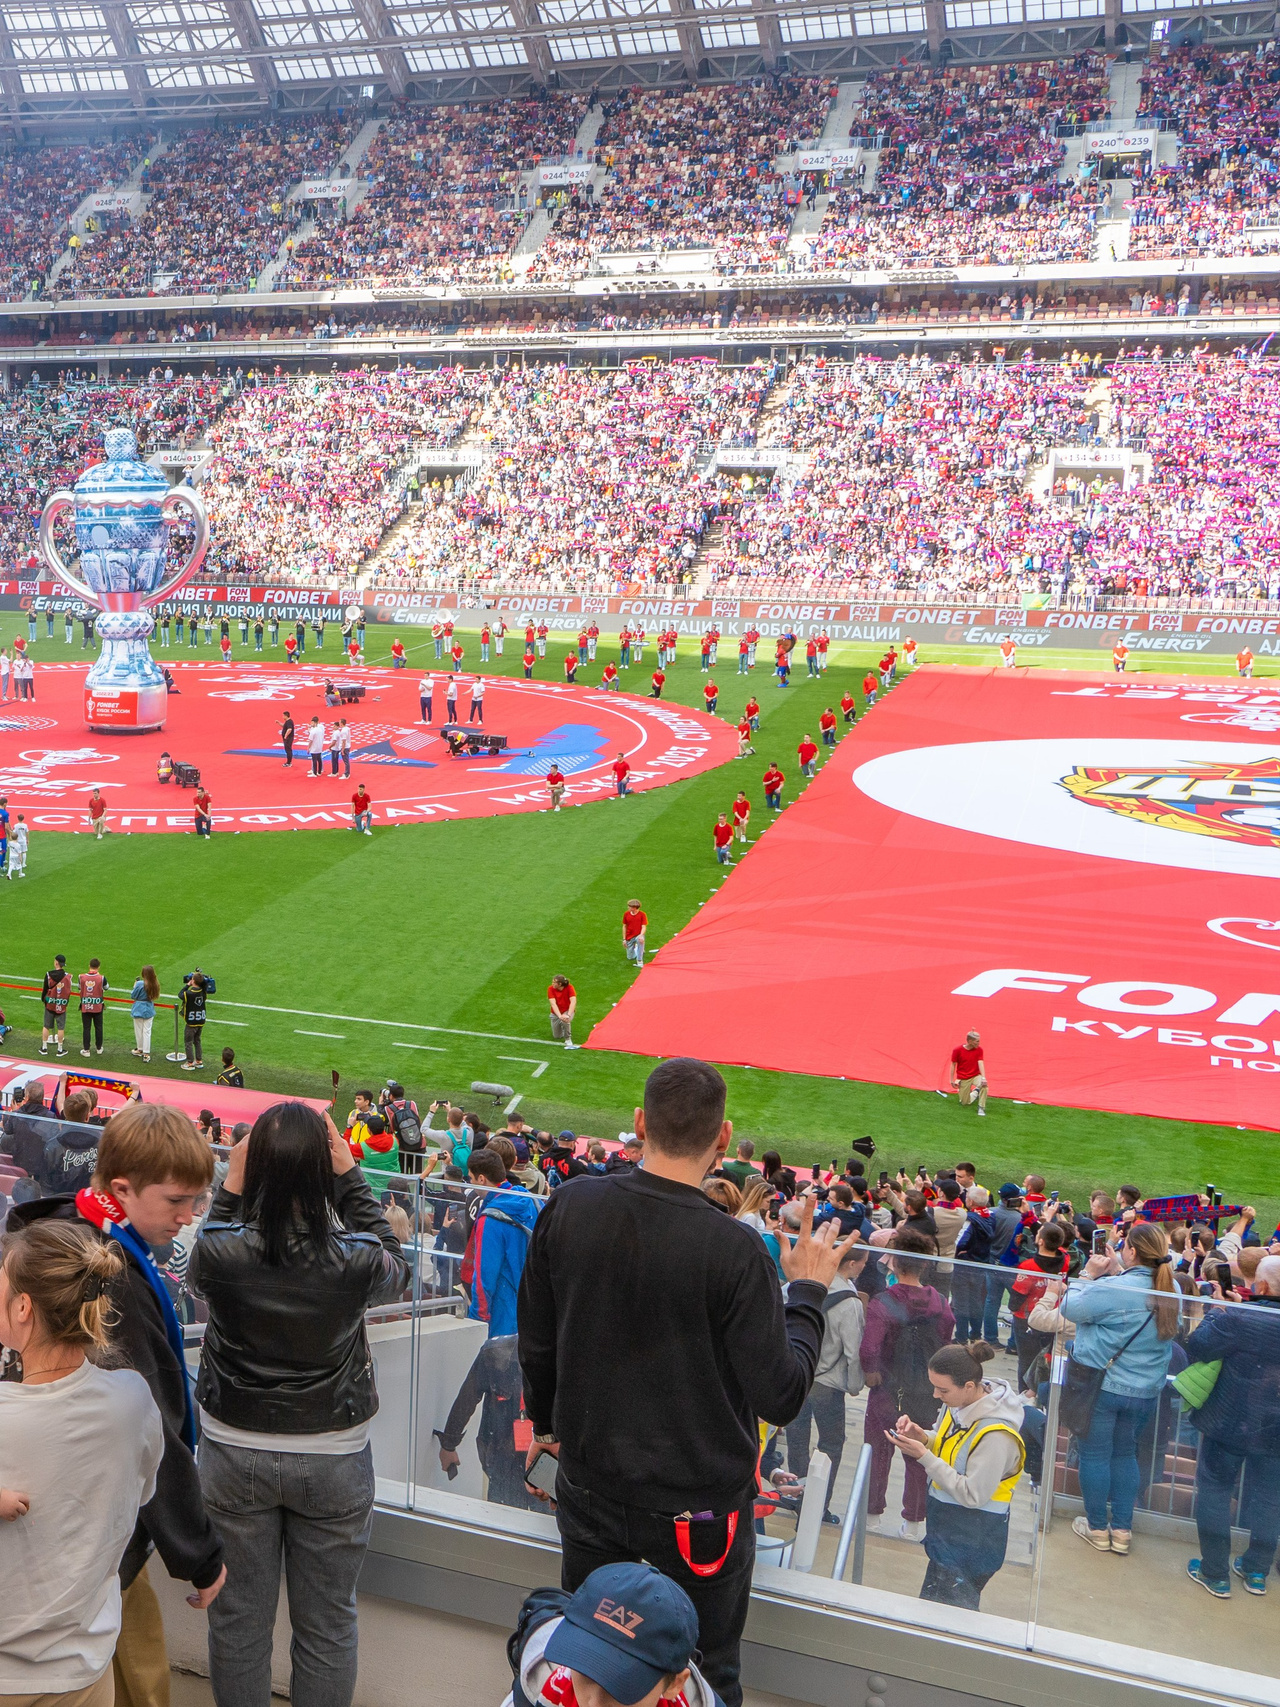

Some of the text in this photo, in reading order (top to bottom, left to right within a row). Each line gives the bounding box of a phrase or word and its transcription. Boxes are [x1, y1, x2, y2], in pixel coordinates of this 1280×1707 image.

[1098, 137, 1150, 149] 240 239
[808, 155, 854, 166] 242 241
[548, 172, 563, 180] 244
[313, 186, 327, 194] 246
[21, 581, 38, 589] FON
[228, 587, 249, 596] FON
[170, 587, 218, 601] NBET
[263, 590, 332, 604] FONBET
[340, 590, 362, 598] FON
[373, 593, 445, 608] FONBET
[497, 597, 573, 612] FONBET
[583, 597, 606, 606] FON
[714, 602, 738, 610] FON
[620, 601, 699, 617] FONBET
[756, 604, 841, 620] FONBET
[852, 606, 878, 614] FON
[998, 610, 1024, 619] FON
[892, 608, 981, 625] FONBET
[1044, 613, 1139, 630] FONBET
[1153, 615, 1180, 624] FON
[729, 622, 738, 633] К
[809, 623, 901, 642] СИТУАЦИИ
[1195, 617, 1280, 634] FONBE
[646, 745, 709, 768] 2023
[188, 1011, 206, 1021] 550
[1051, 1016, 1280, 1056] КУБО
[596, 1597, 645, 1631] EA7
